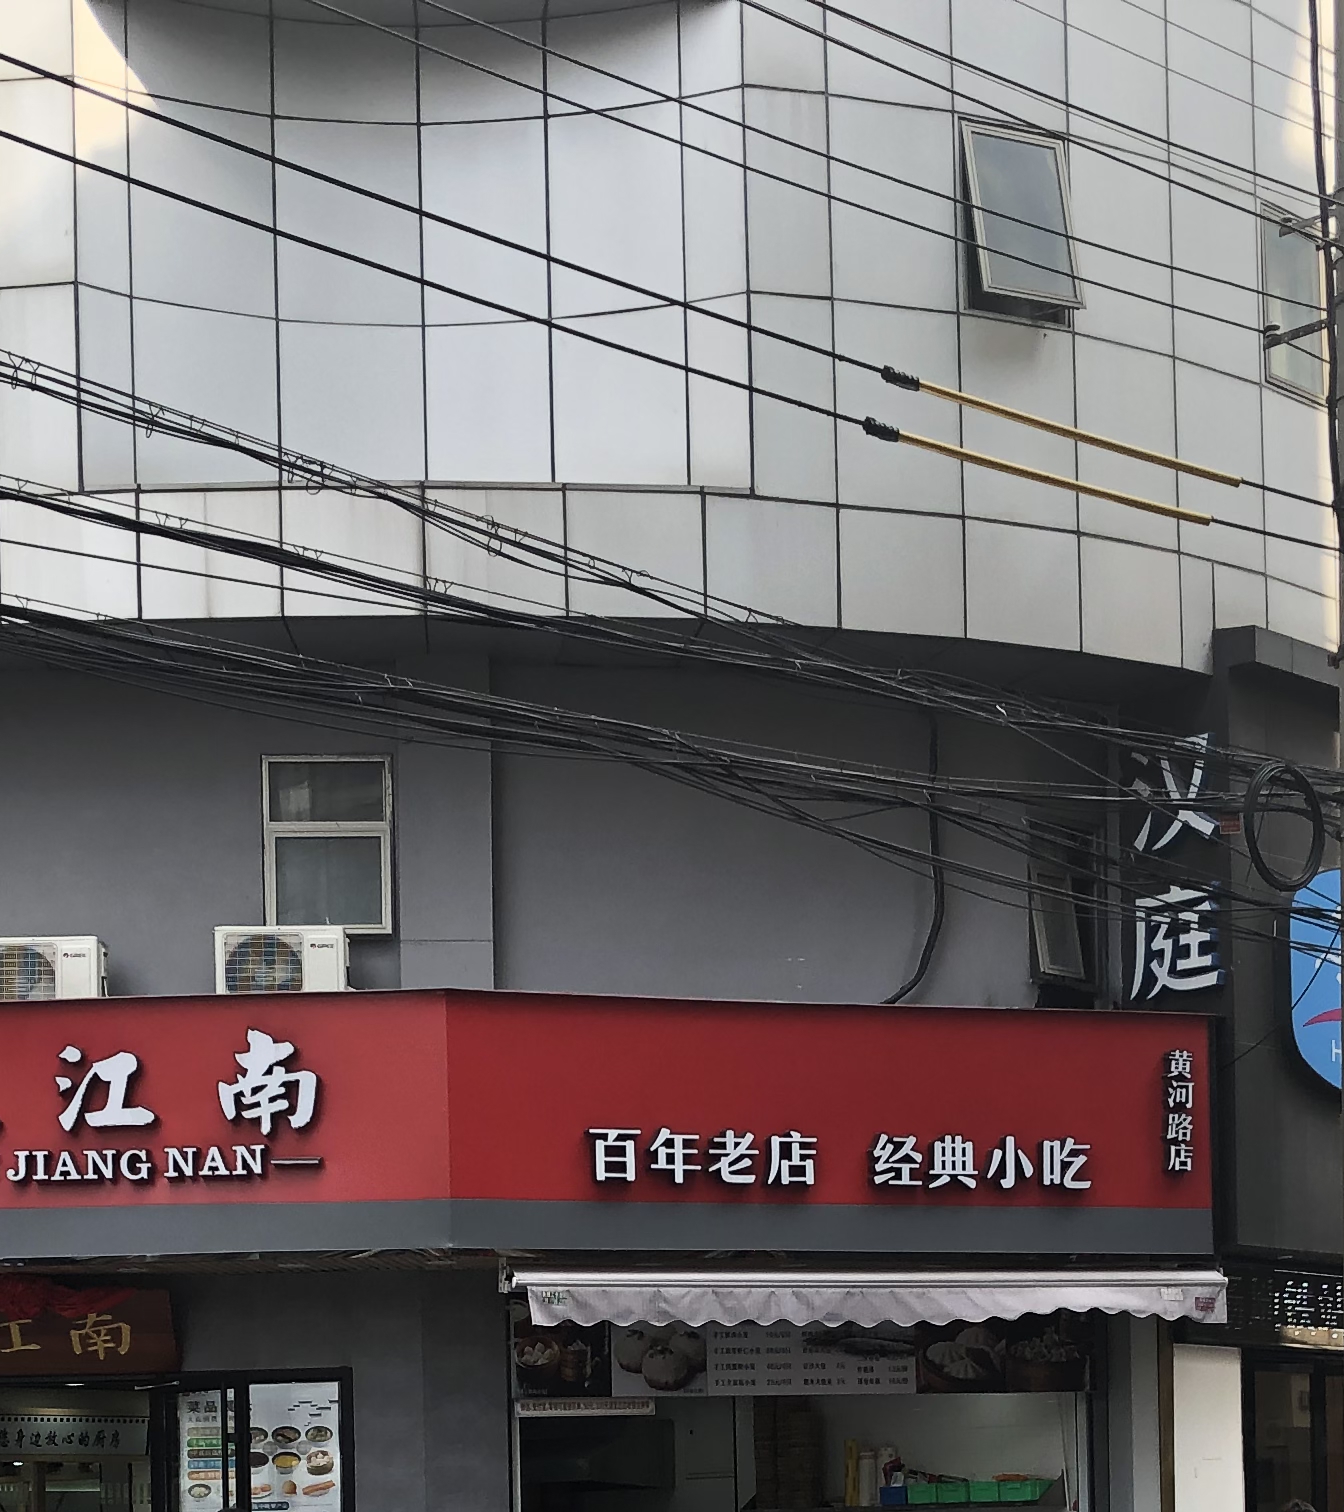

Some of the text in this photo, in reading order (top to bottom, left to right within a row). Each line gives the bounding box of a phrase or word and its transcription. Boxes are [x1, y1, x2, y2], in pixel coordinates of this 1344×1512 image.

[1130, 732, 1222, 1000] 汉庭
[1166, 1048, 1194, 1173] 黄河路店
[6, 1147, 153, 1183] JIANG
[163, 1143, 265, 1179] NAN
[588, 1128, 1092, 1190] 百年老店 经典小吃
